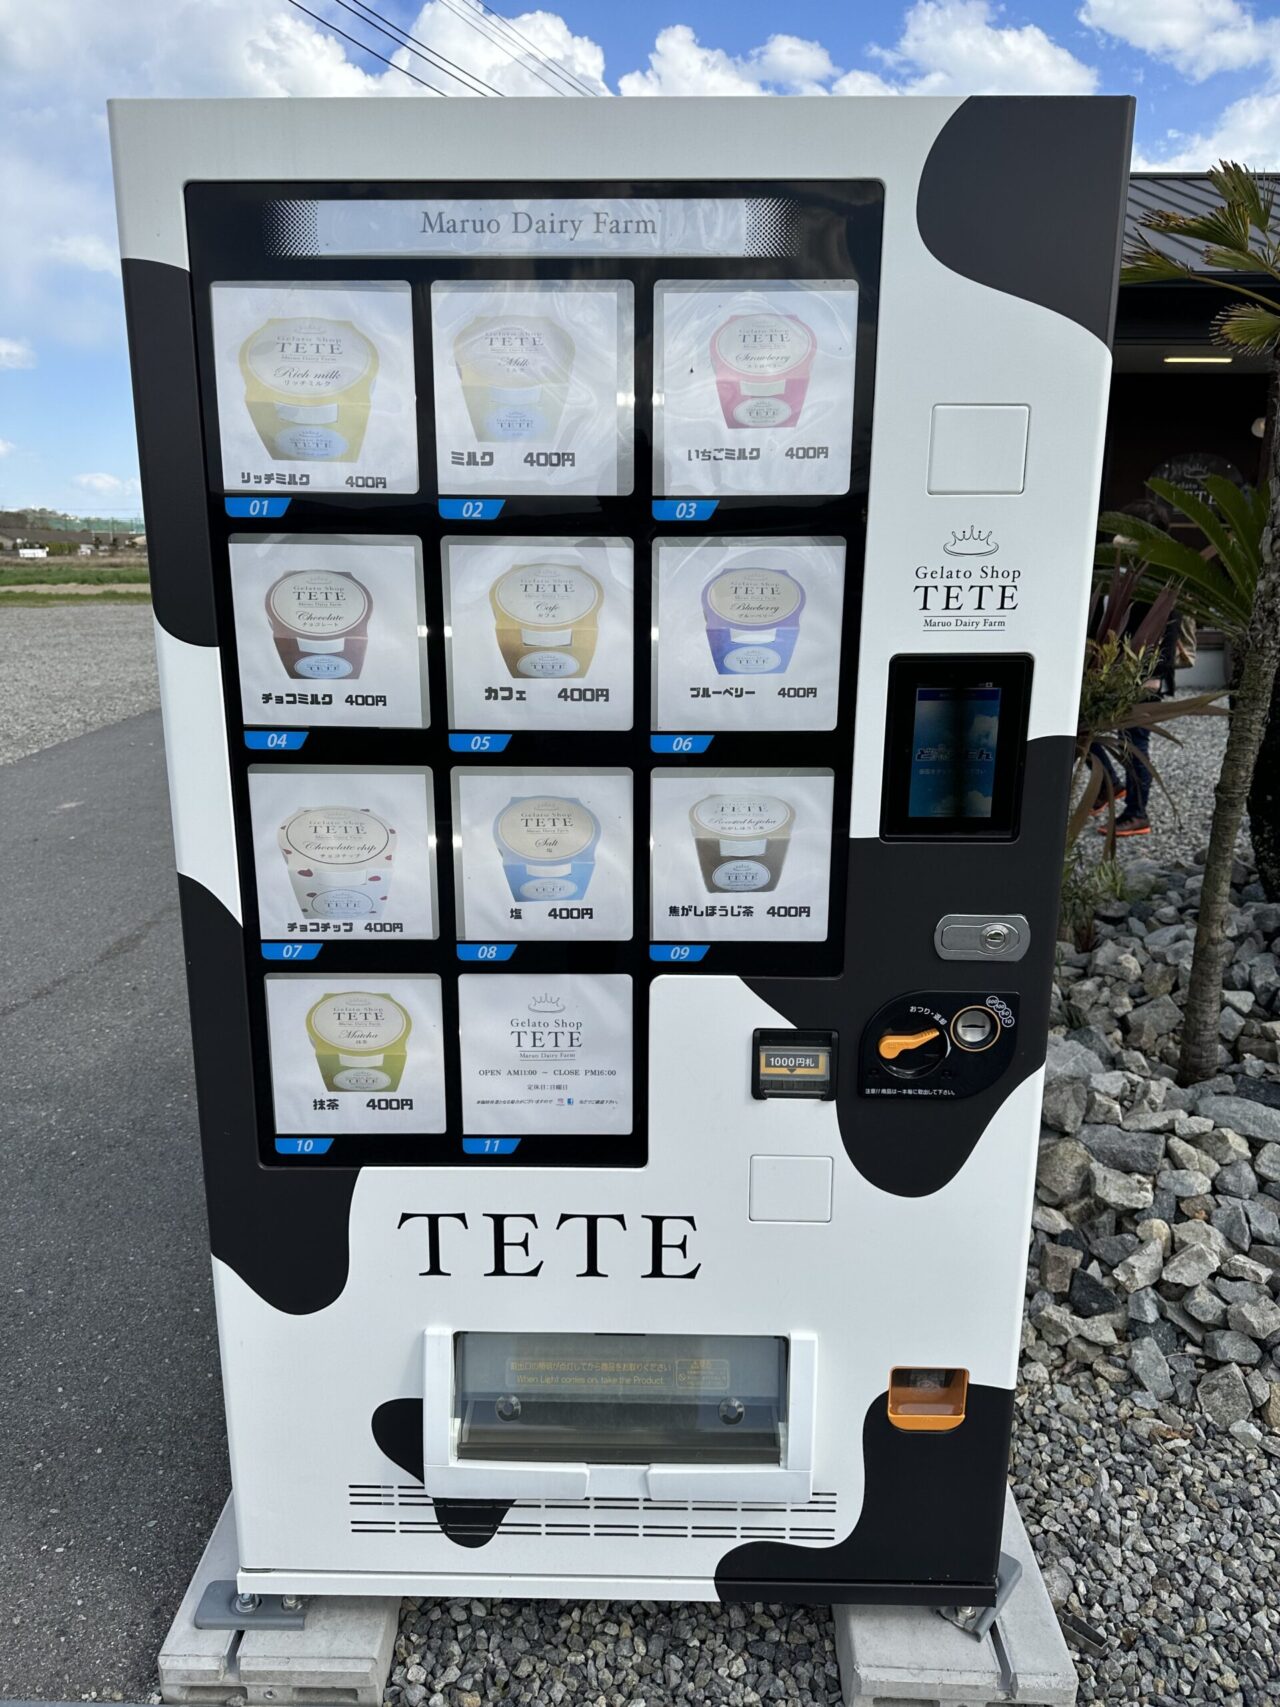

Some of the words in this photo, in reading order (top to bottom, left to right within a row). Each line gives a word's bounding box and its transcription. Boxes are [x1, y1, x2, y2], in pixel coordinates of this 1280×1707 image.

[420, 211, 501, 234] Maruo
[511, 211, 583, 241] Dairy
[594, 211, 657, 235] Farm
[486, 336, 544, 346] TETE
[738, 334, 791, 343] TETE
[276, 342, 343, 354] TETE
[498, 357, 528, 367] Milk
[735, 353, 791, 362] Strawberry
[274, 367, 310, 379] Rich
[313, 369, 341, 380] milk
[450, 451, 494, 467] ミルク
[523, 452, 576, 467] 400円
[687, 447, 761, 461] いちごミルク
[784, 446, 829, 460] 400円
[240, 472, 310, 486] リッチミルク
[345, 476, 387, 489] 400円
[249, 500, 269, 517] 01
[462, 502, 483, 518] 02
[675, 502, 697, 519] 03
[915, 566, 973, 580] Gelato
[980, 566, 1022, 583] Shop
[520, 584, 575, 593] TETE
[730, 586, 781, 595] TETE
[292, 591, 346, 601] TETE
[913, 585, 1019, 611] TETE
[730, 603, 780, 613] Blueberry
[296, 611, 344, 621] Chocolate
[923, 618, 952, 628] Maruo
[954, 618, 981, 629] Dairy
[983, 618, 1006, 628] Farm
[484, 686, 527, 701] カフェ
[557, 687, 610, 702] 400円
[689, 687, 756, 698] ブルーベリー
[777, 687, 818, 698] 400円
[261, 692, 333, 705] チョコミルク
[344, 694, 387, 707] 400円
[267, 734, 287, 748] 04
[470, 736, 491, 750] 05
[672, 737, 693, 751] 06
[714, 805, 769, 813] TETE
[520, 818, 574, 827] TETE
[309, 825, 367, 834] TETE
[305, 842, 353, 851] Chocolate
[355, 843, 377, 853] chip
[534, 838, 559, 847] Salt
[509, 908, 523, 920] 塩
[547, 907, 594, 920] 400円
[668, 905, 754, 917] 焦がしほうじ茶
[766, 906, 811, 918] 400円
[287, 922, 353, 933] チョコチップ
[364, 922, 404, 933] 400円
[282, 945, 302, 958] 07
[477, 946, 497, 959] 08
[670, 946, 690, 960] 09
[332, 1012, 385, 1021] TETE
[510, 1018, 550, 1028] Gelato
[554, 1018, 583, 1030] Shop
[338, 1030, 378, 1039] Matcha
[510, 1030, 584, 1048] TETE
[769, 1057, 815, 1067] 1000円札
[312, 1098, 340, 1111] 抹茶
[366, 1098, 413, 1111] 400円
[296, 1139, 314, 1152] 10
[484, 1139, 501, 1152] 11
[397, 1212, 702, 1280] TETE
[516, 1374, 539, 1385] When
[540, 1374, 559, 1386] Light
